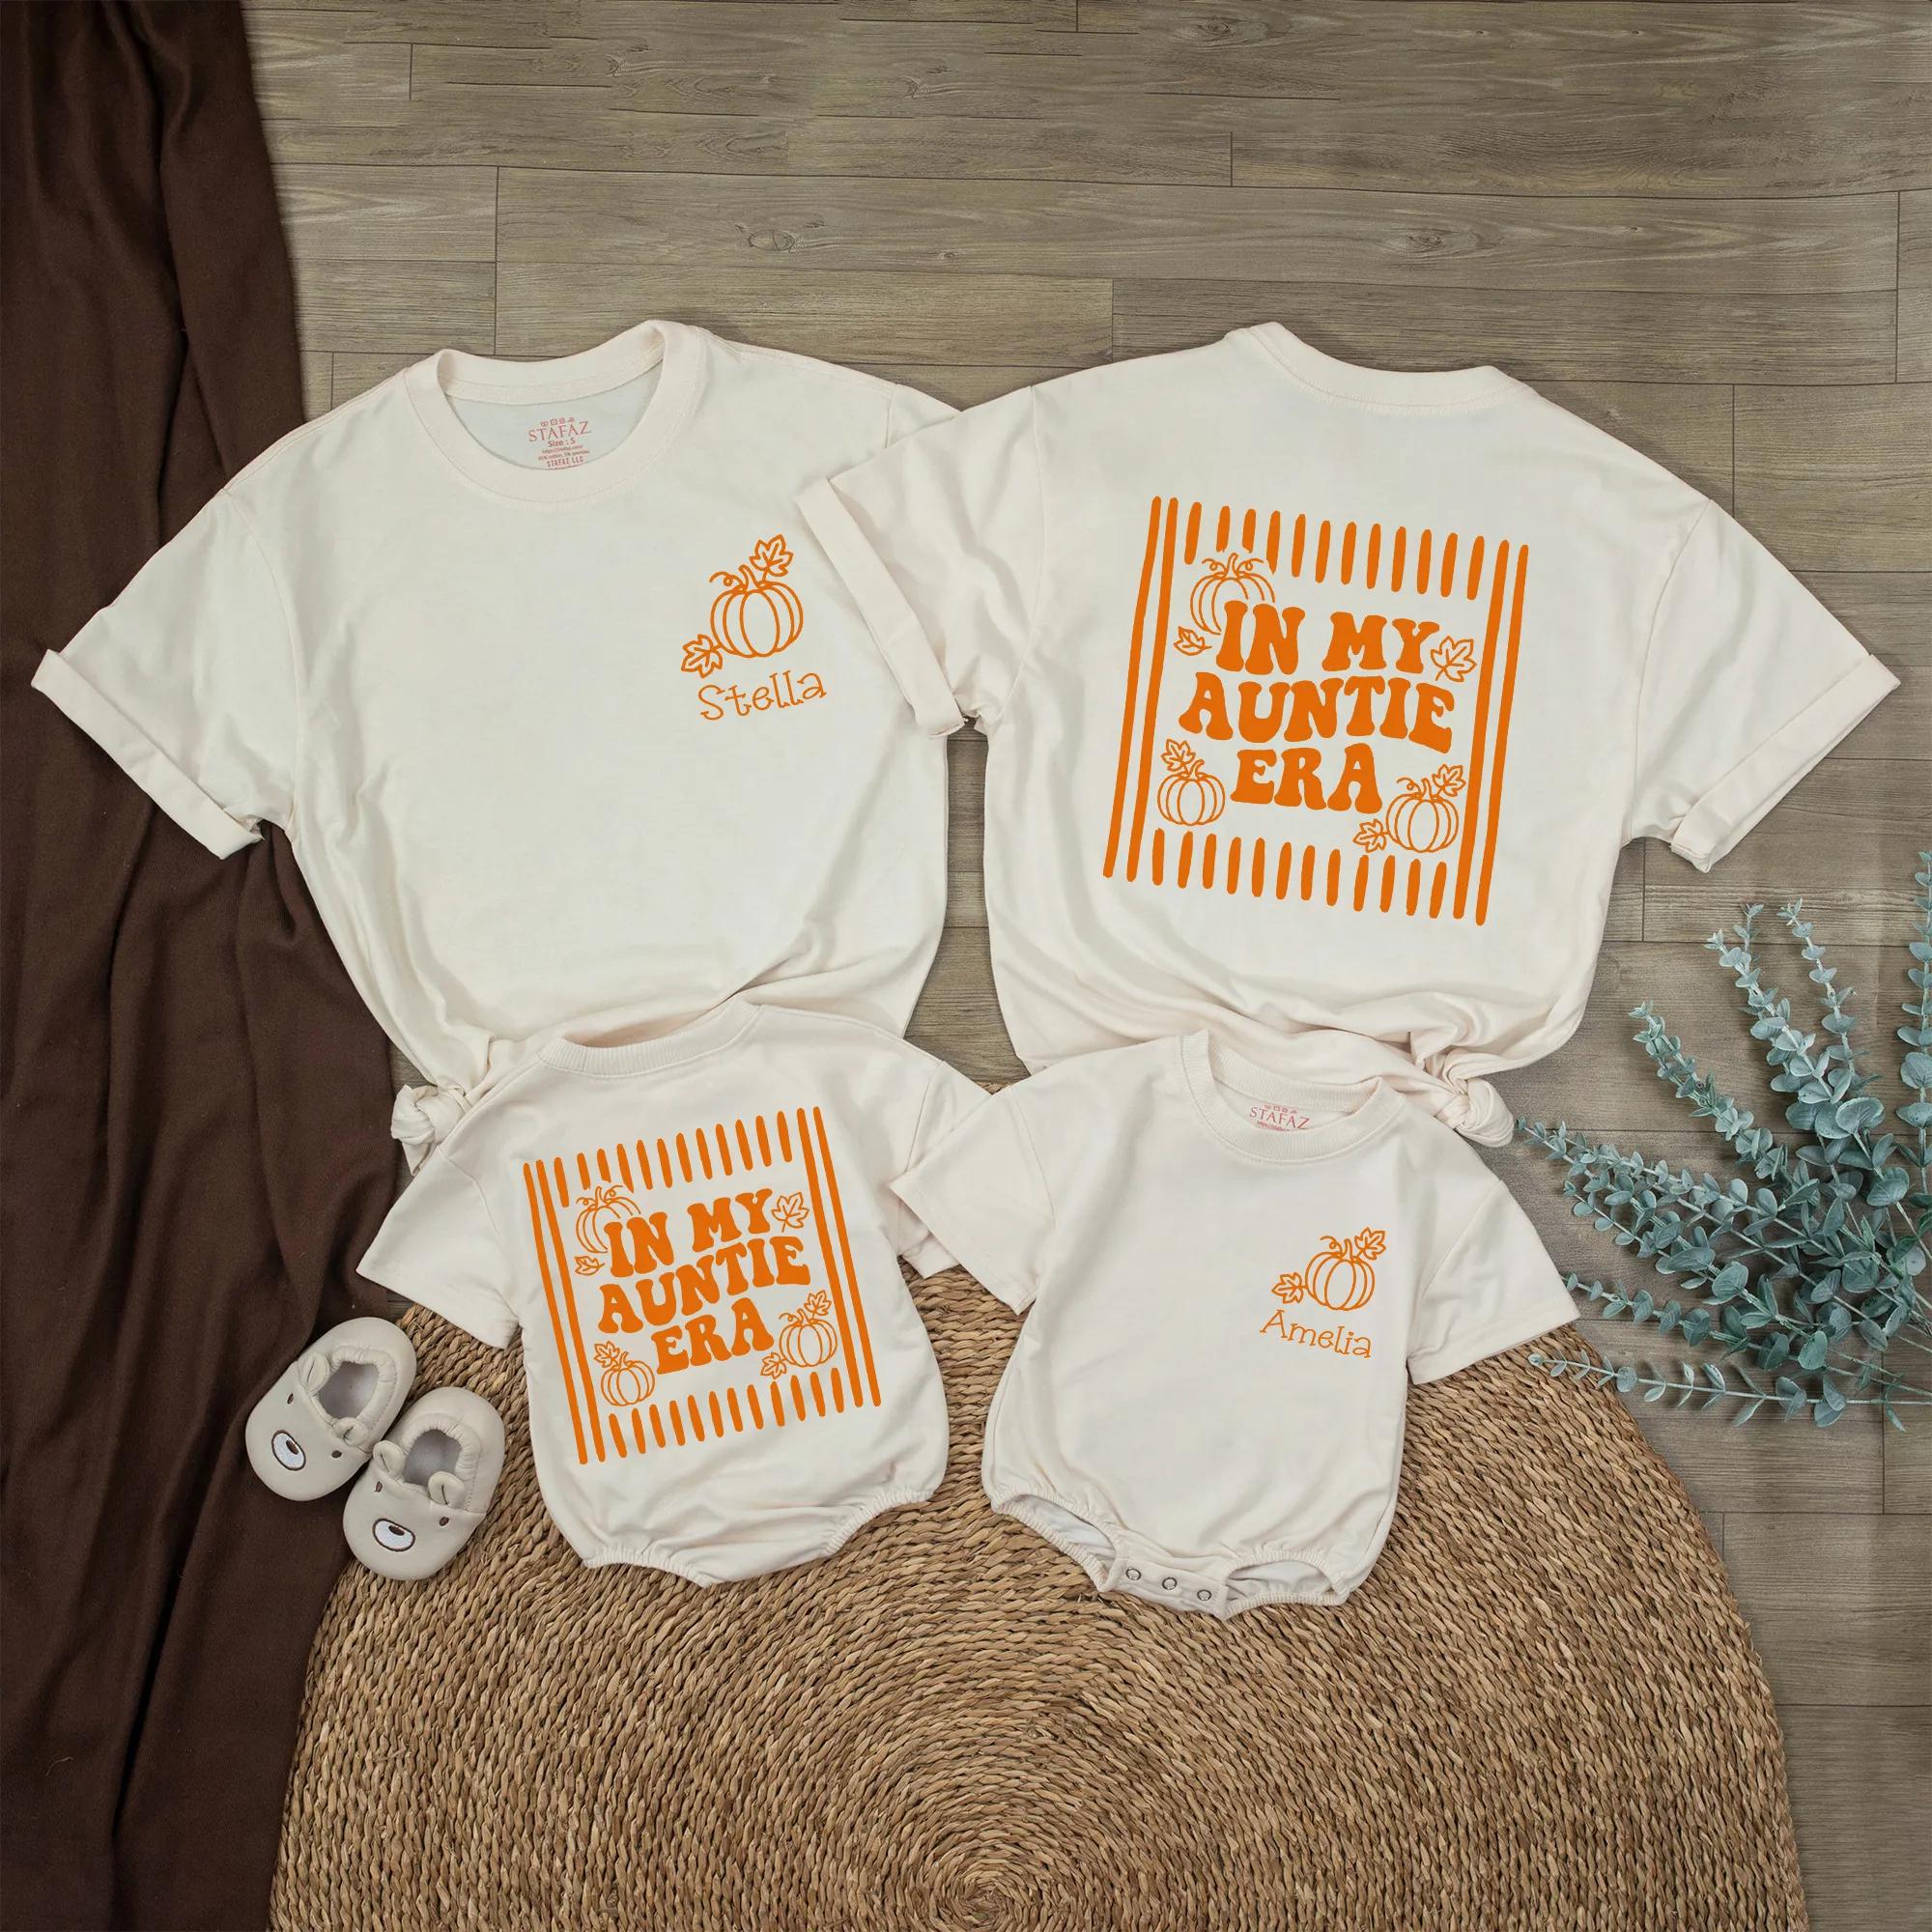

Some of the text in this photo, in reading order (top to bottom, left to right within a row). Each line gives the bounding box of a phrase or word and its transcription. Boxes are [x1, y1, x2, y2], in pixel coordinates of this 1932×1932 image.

[527, 420, 592, 442] STAFAZ
[547, 457, 569, 468] STAFAZ
[1215, 600, 1440, 675] IN MY
[698, 670, 826, 721] Stella
[1179, 671, 1455, 753] AUNTIE
[1230, 743, 1382, 814] ERA
[1249, 1106, 1310, 1130] STAFAZ
[604, 1187, 773, 1278] IN MY
[598, 1236, 810, 1334] AUNTIE
[650, 1297, 776, 1376] ERA
[1260, 1309, 1371, 1358] Amelia
